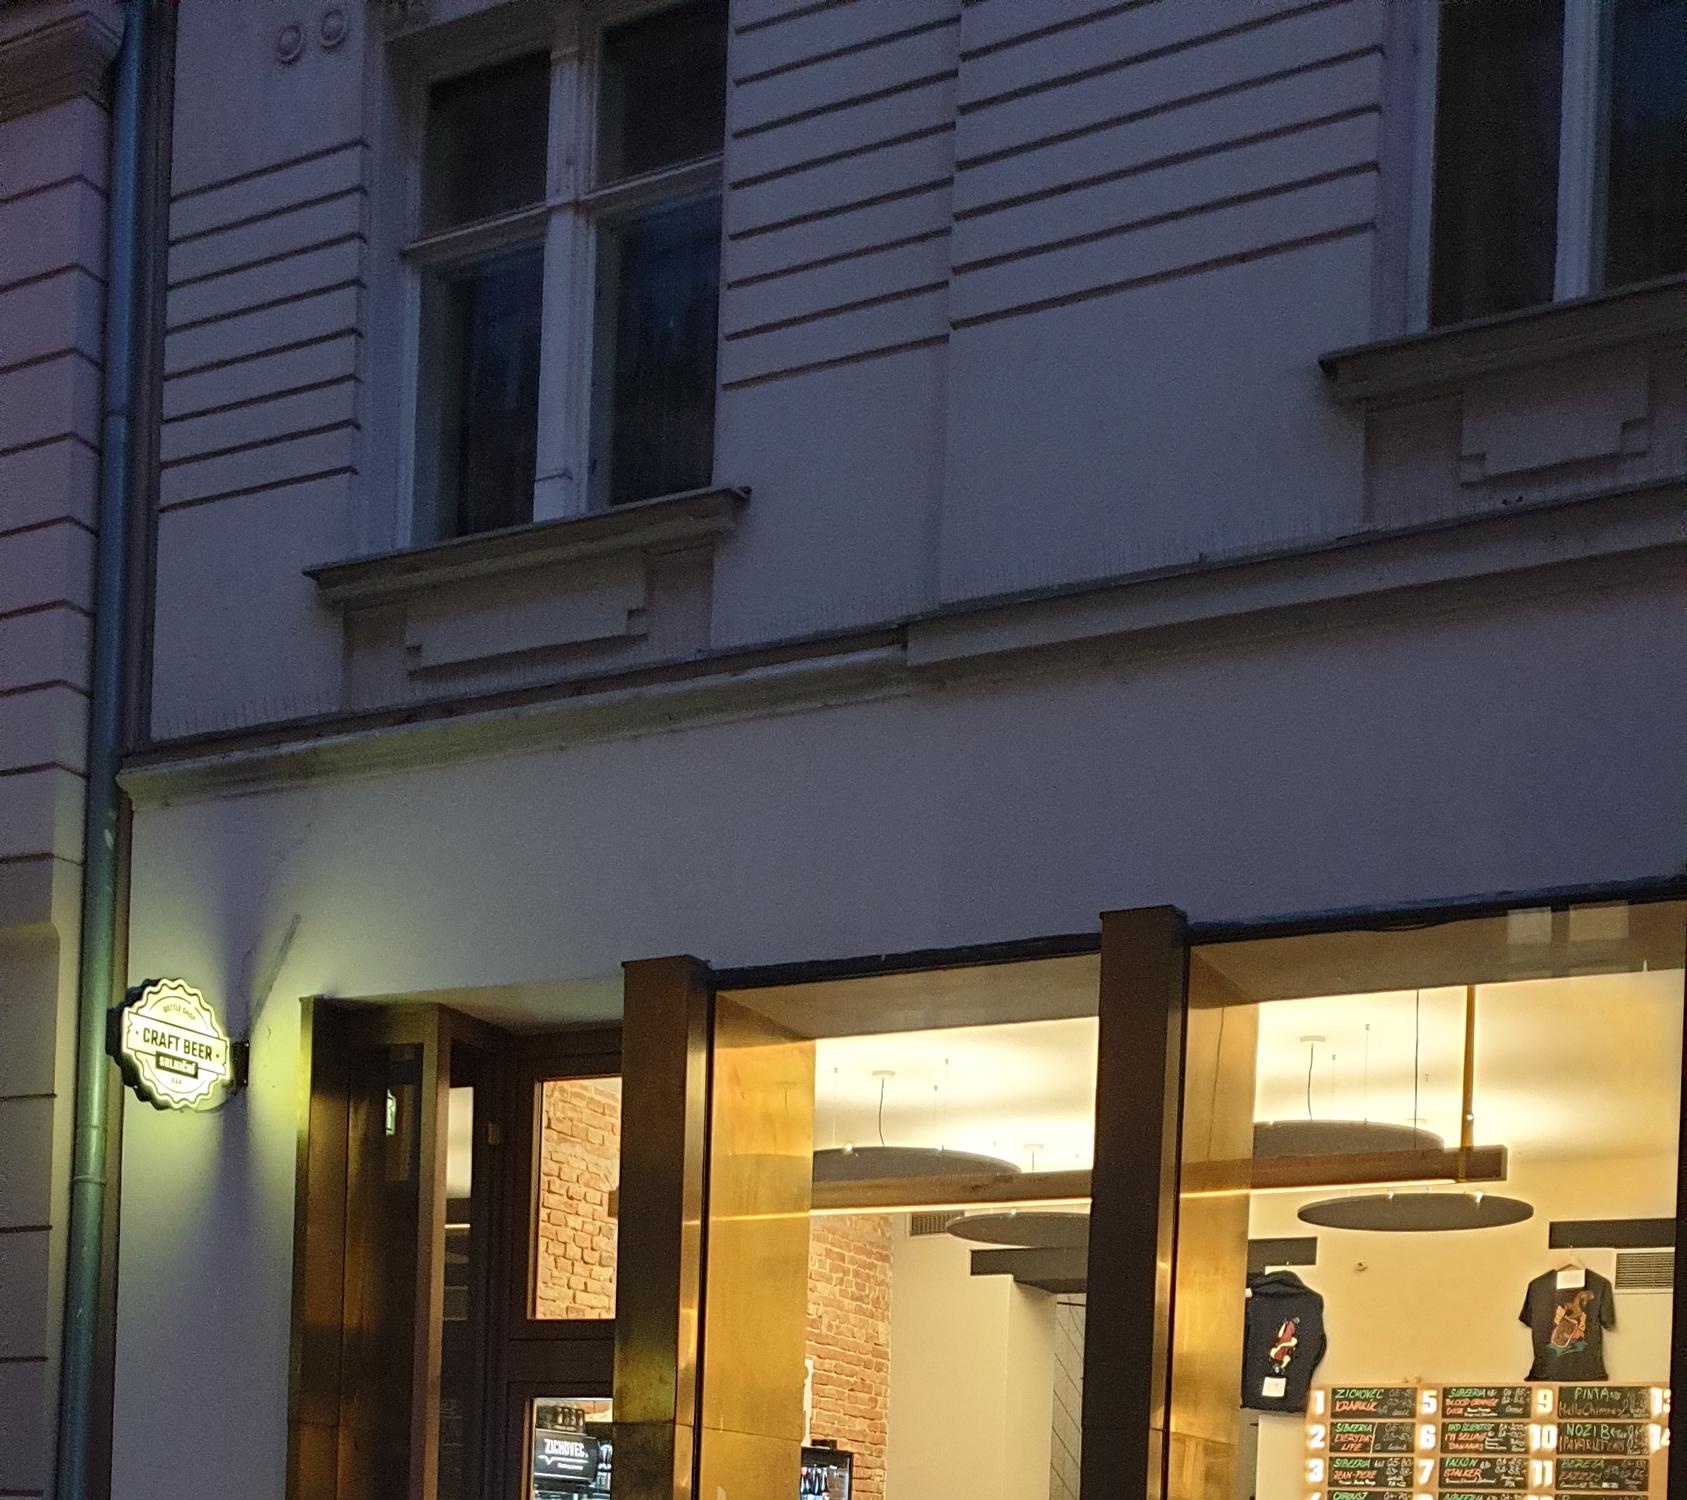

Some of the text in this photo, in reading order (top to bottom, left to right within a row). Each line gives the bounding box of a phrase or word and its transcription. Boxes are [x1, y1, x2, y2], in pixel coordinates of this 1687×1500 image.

[143, 1027, 213, 1062] CRAFT BEER
[1314, 1390, 1325, 1415] 1
[1421, 1389, 1438, 1415] 5
[1537, 1389, 1553, 1413] 9
[1309, 1424, 1325, 1449] 2
[1420, 1424, 1437, 1450] 6
[1529, 1424, 1558, 1451] 10
[1308, 1458, 1324, 1482] 3
[1419, 1459, 1435, 1487] 7
[1532, 1459, 1554, 1488] 11
